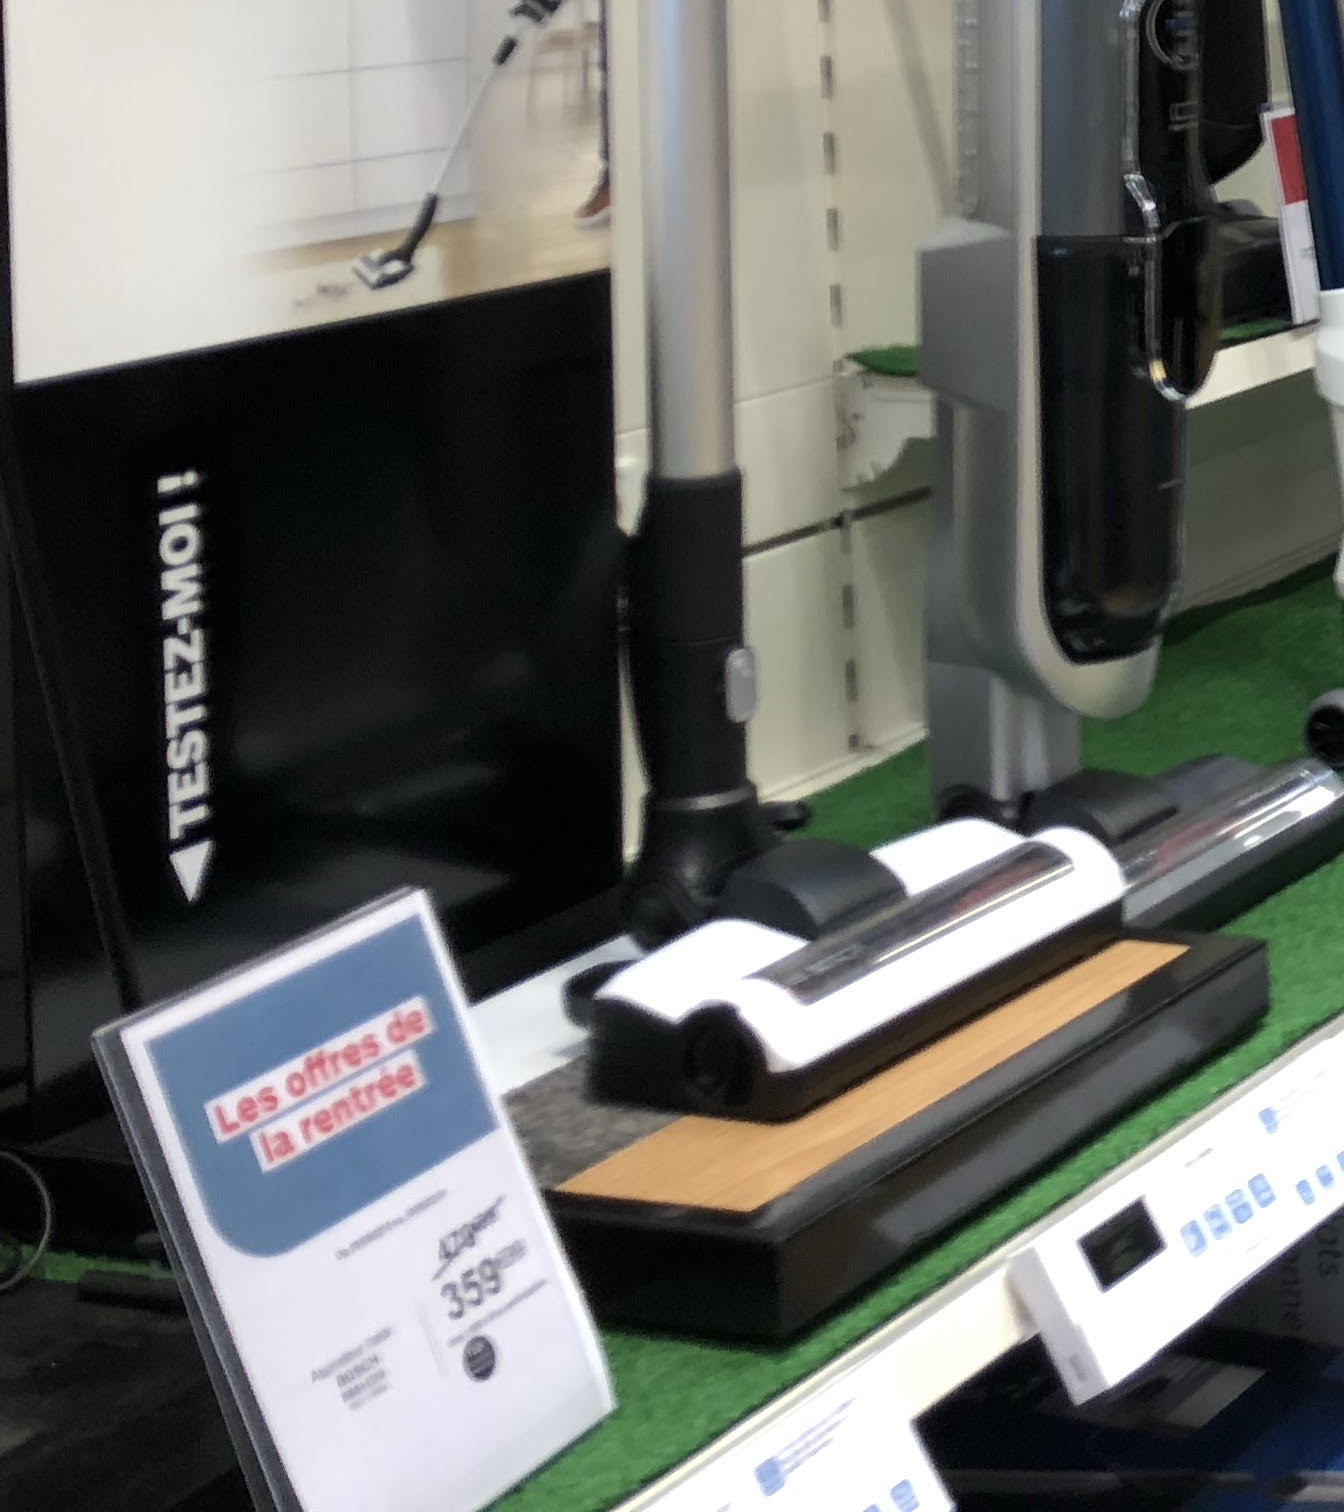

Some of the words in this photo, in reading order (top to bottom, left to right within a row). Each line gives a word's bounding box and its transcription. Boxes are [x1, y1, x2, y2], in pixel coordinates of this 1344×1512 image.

[158, 502, 210, 839] TESTEZ-MOI
[213, 1085, 279, 1135] Les
[285, 1034, 380, 1098] offres
[386, 1009, 425, 1044] de
[258, 1130, 296, 1164] la
[298, 1063, 416, 1144] rentrée
[440, 1258, 501, 1320] 359
